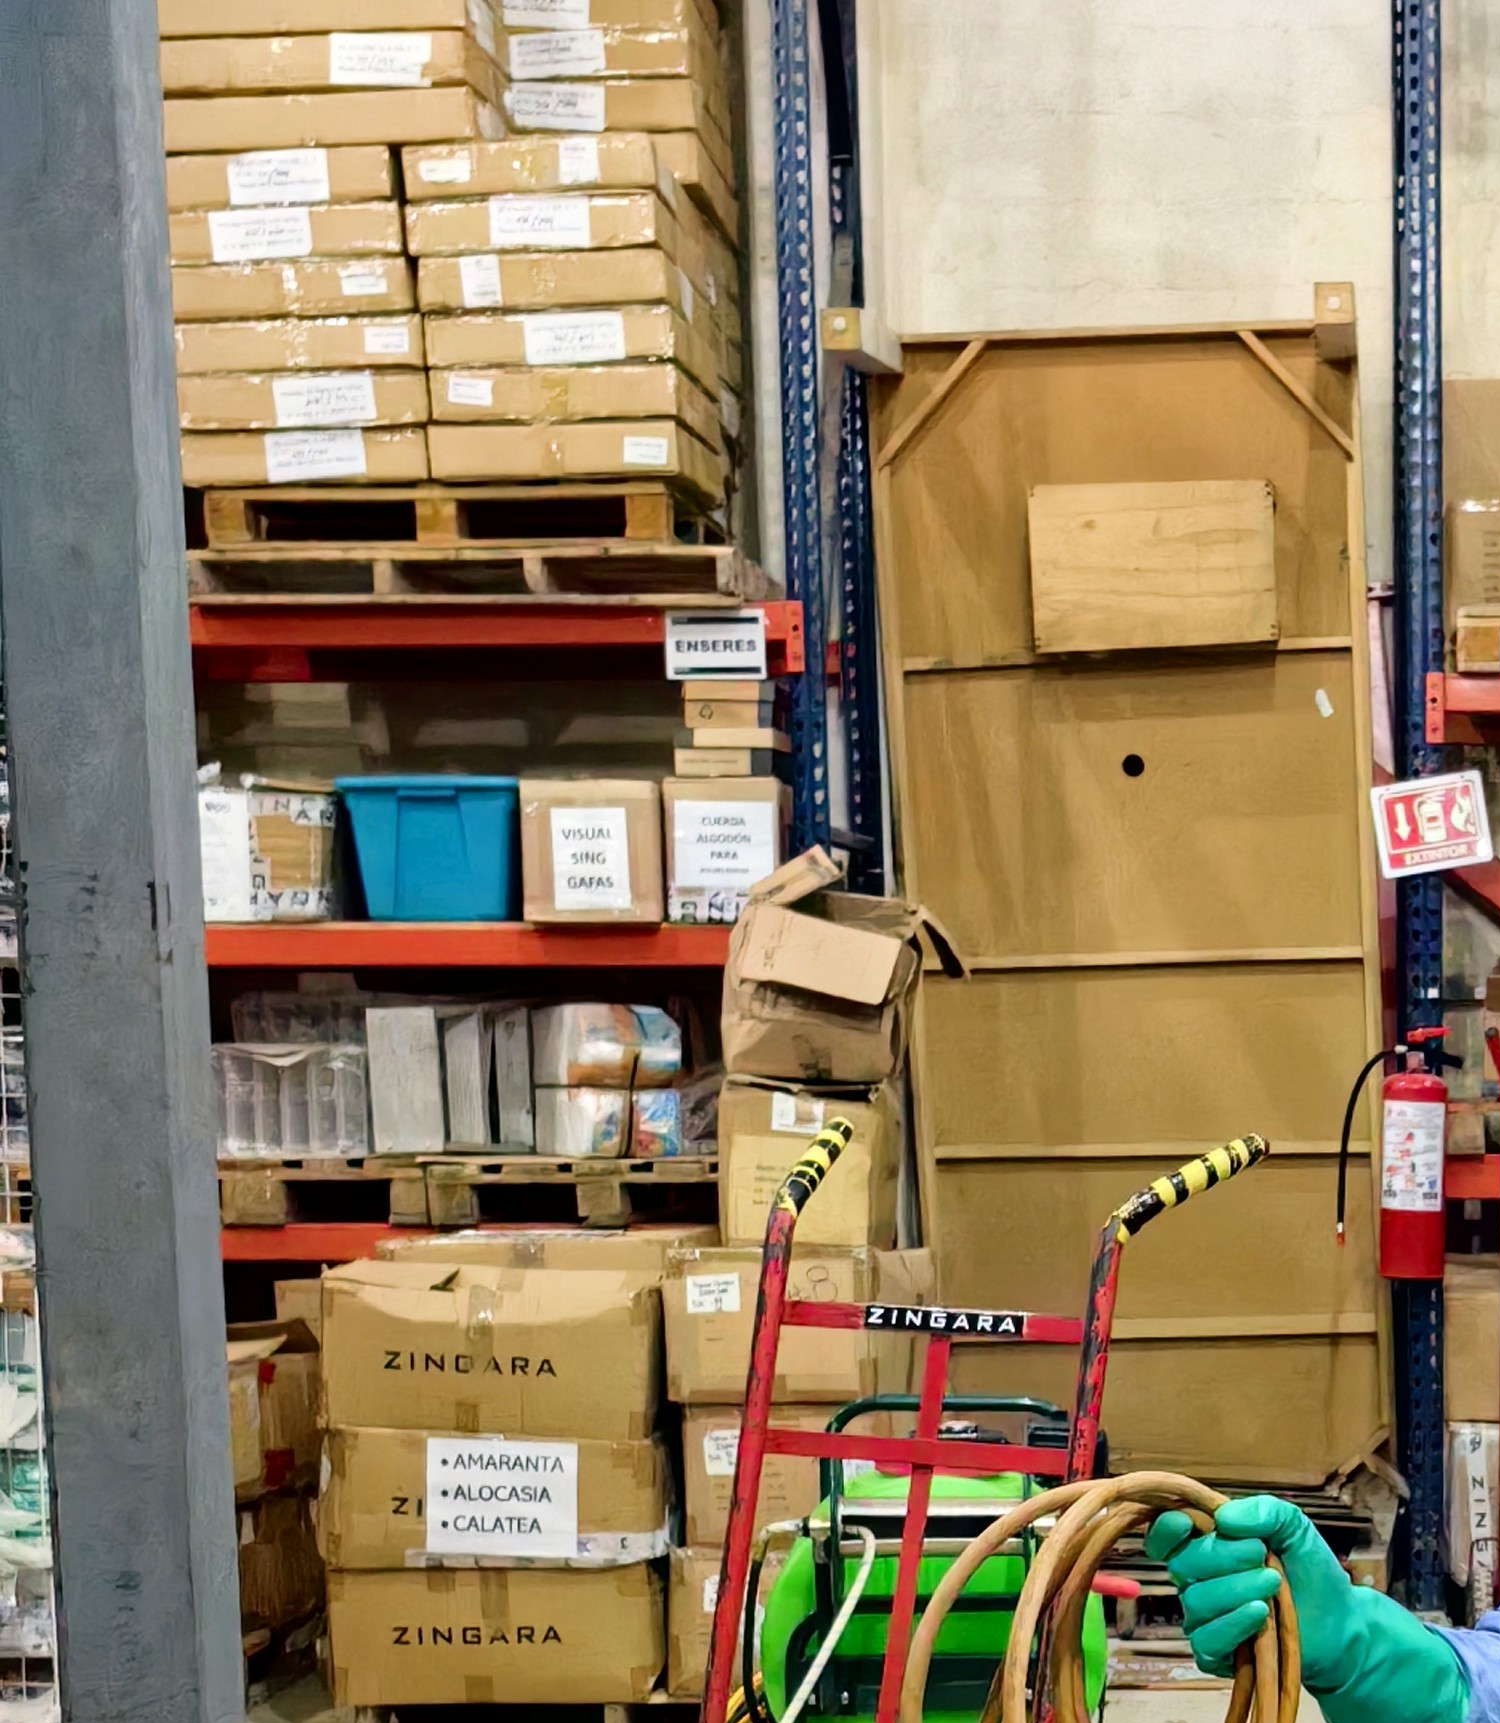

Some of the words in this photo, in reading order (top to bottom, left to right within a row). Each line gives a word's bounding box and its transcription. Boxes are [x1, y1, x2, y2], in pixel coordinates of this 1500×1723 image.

[675, 639, 757, 653] ENSERES
[561, 827, 613, 841] VISUAL
[567, 876, 615, 890] GAFAS
[868, 1307, 1017, 1333] ZINGARA
[453, 1453, 564, 1473] AMARANTA
[453, 1484, 552, 1503] ALOCASIA
[453, 1515, 542, 1534] CALATEA
[392, 1626, 562, 1645] ZINGARA
